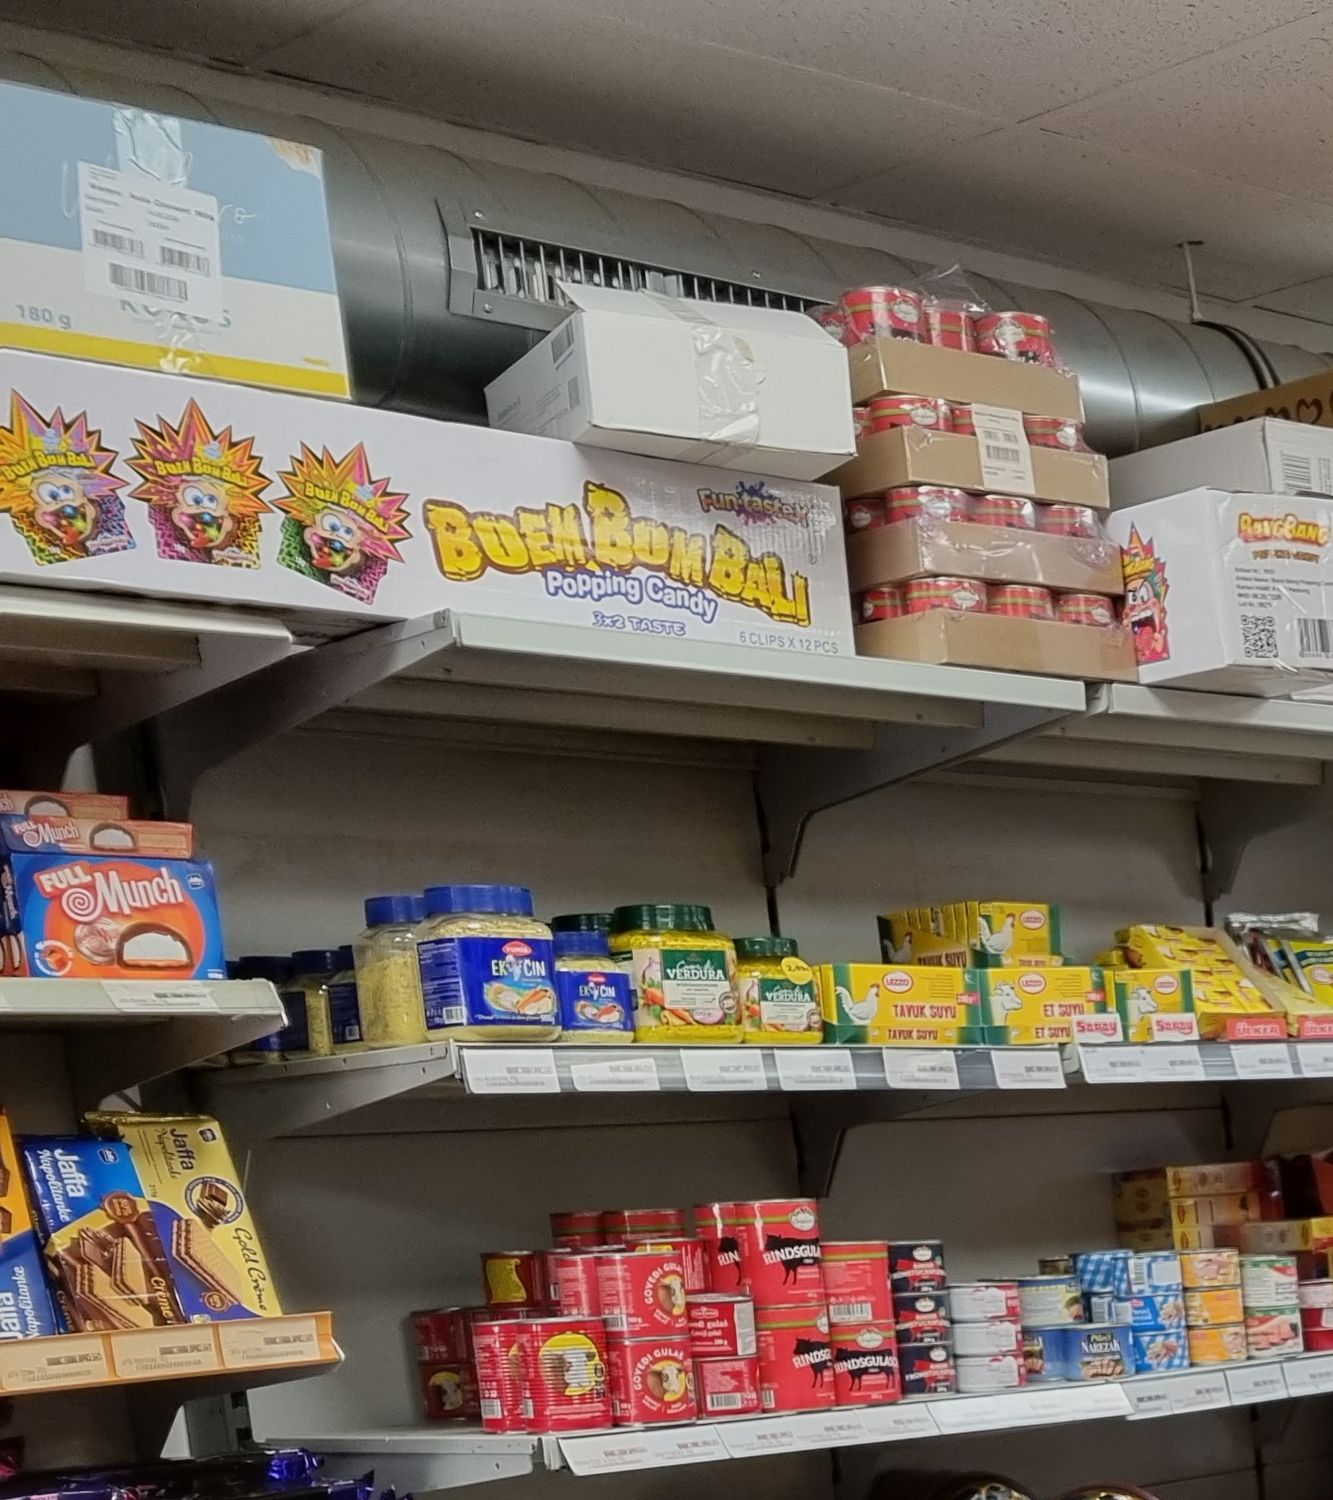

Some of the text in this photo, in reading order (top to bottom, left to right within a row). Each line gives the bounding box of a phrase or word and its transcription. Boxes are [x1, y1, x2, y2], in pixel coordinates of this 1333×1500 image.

[16, 303, 53, 324] 180
[544, 568, 719, 624] Popping Candy
[628, 614, 687, 637] TASTE
[749, 632, 786, 649] CLIPS
[813, 639, 840, 655] PCS
[37, 822, 80, 846] Munch
[39, 863, 185, 916] FULL Munch
[666, 965, 726, 982] VERDURA
[892, 1003, 957, 1019] TAVUK SUYU
[1043, 1003, 1085, 1017] ET SUYU
[888, 1028, 938, 1041] TAVUK SUYU
[1035, 1026, 1071, 1039] ET SUYU
[169, 1127, 195, 1171] Jaffa
[54, 1148, 87, 1199] Jaffa
[36, 1149, 71, 1223] Napolitanke
[234, 1226, 254, 1264] Gold
[763, 1245, 822, 1266] RINDSGULA
[661, 1261, 685, 1276] GULA
[793, 1347, 832, 1369] RINDSG
[633, 1356, 654, 1393] GOVEDI
